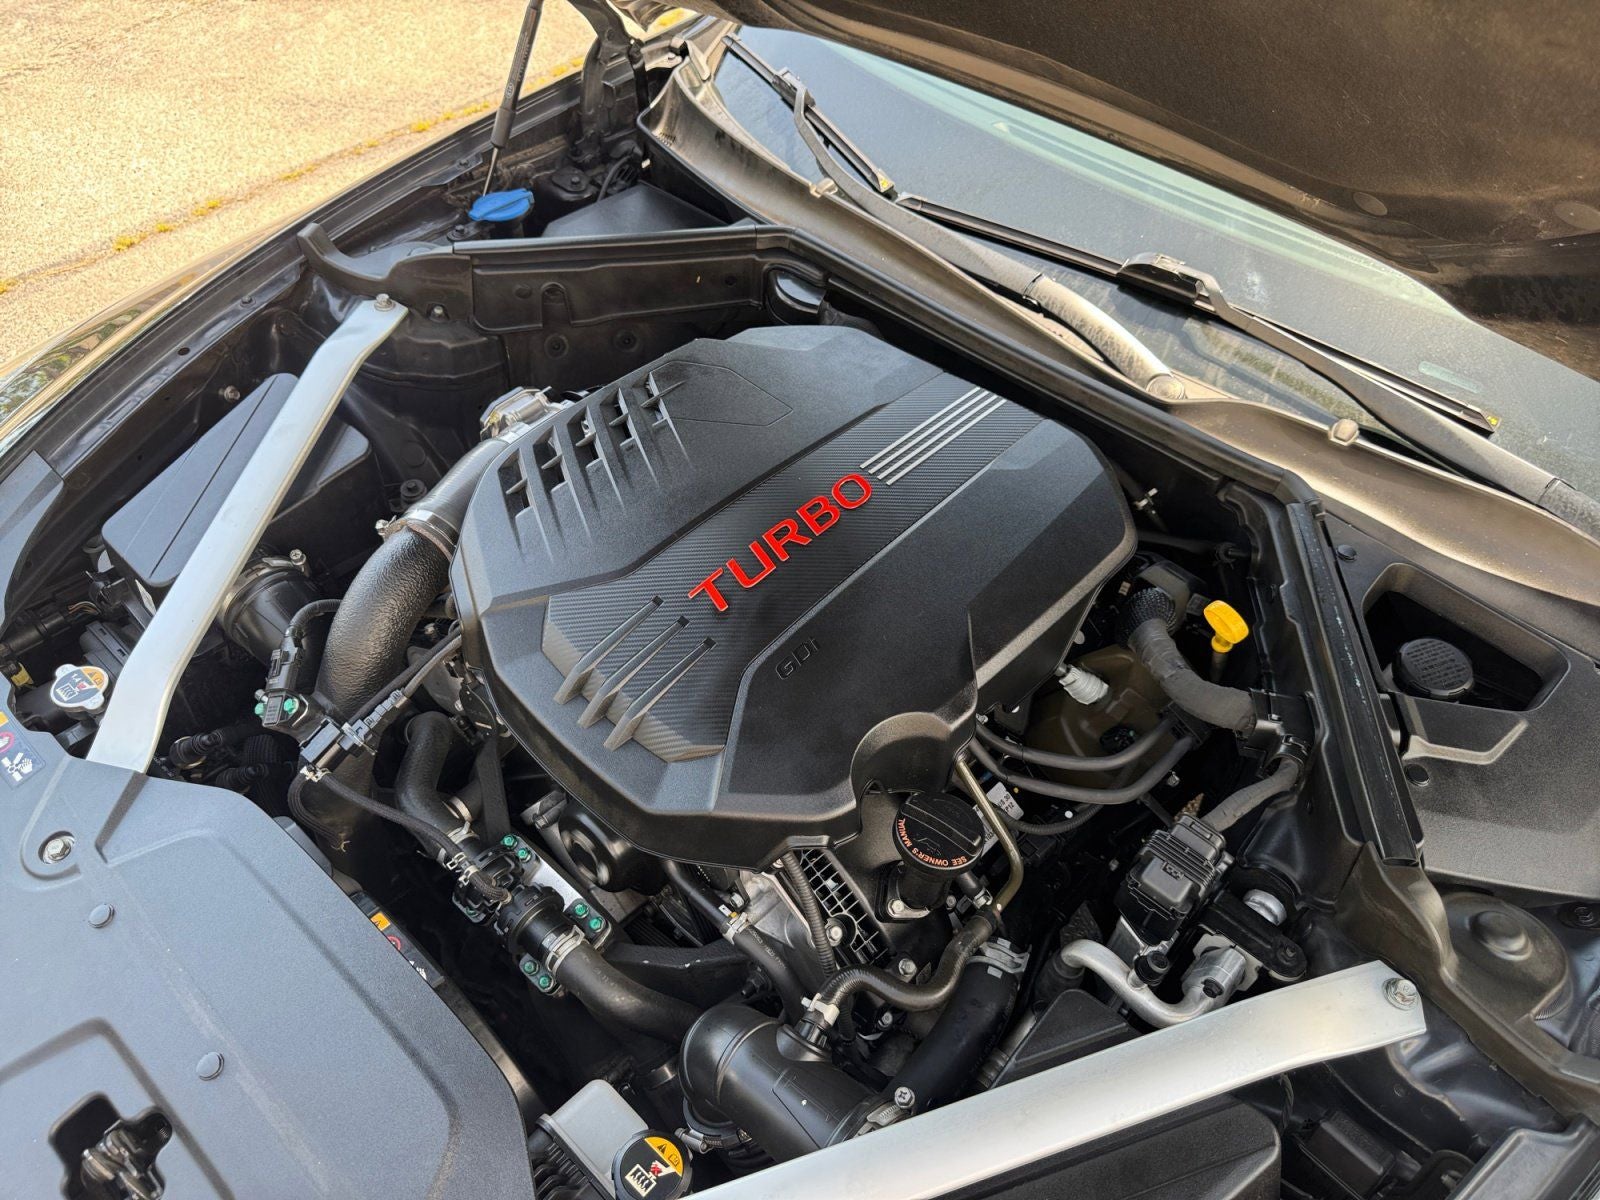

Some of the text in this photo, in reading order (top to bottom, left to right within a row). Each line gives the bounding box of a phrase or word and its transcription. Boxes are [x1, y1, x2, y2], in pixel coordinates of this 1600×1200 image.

[687, 473, 873, 612] TURBO
[897, 818, 968, 867] SEE OWNER'S MANUAL
